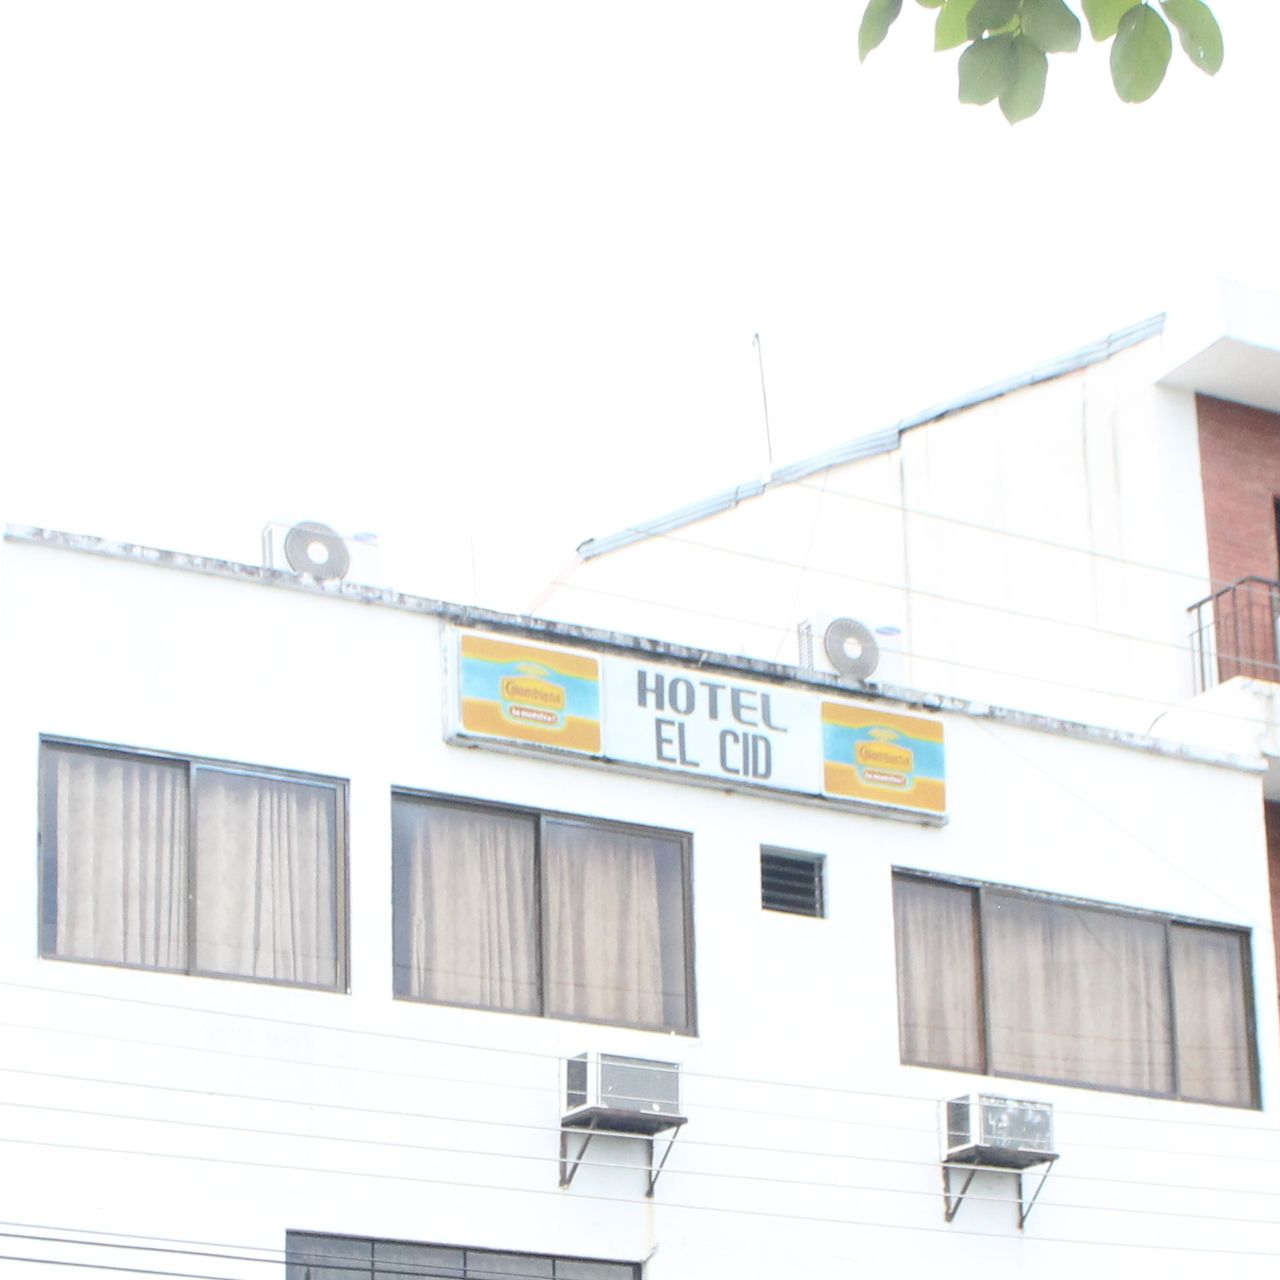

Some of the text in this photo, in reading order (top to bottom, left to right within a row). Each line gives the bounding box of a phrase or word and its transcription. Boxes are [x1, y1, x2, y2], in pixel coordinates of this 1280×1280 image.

[637, 670, 788, 733] HOTEL
[655, 717, 772, 779] EL CID
